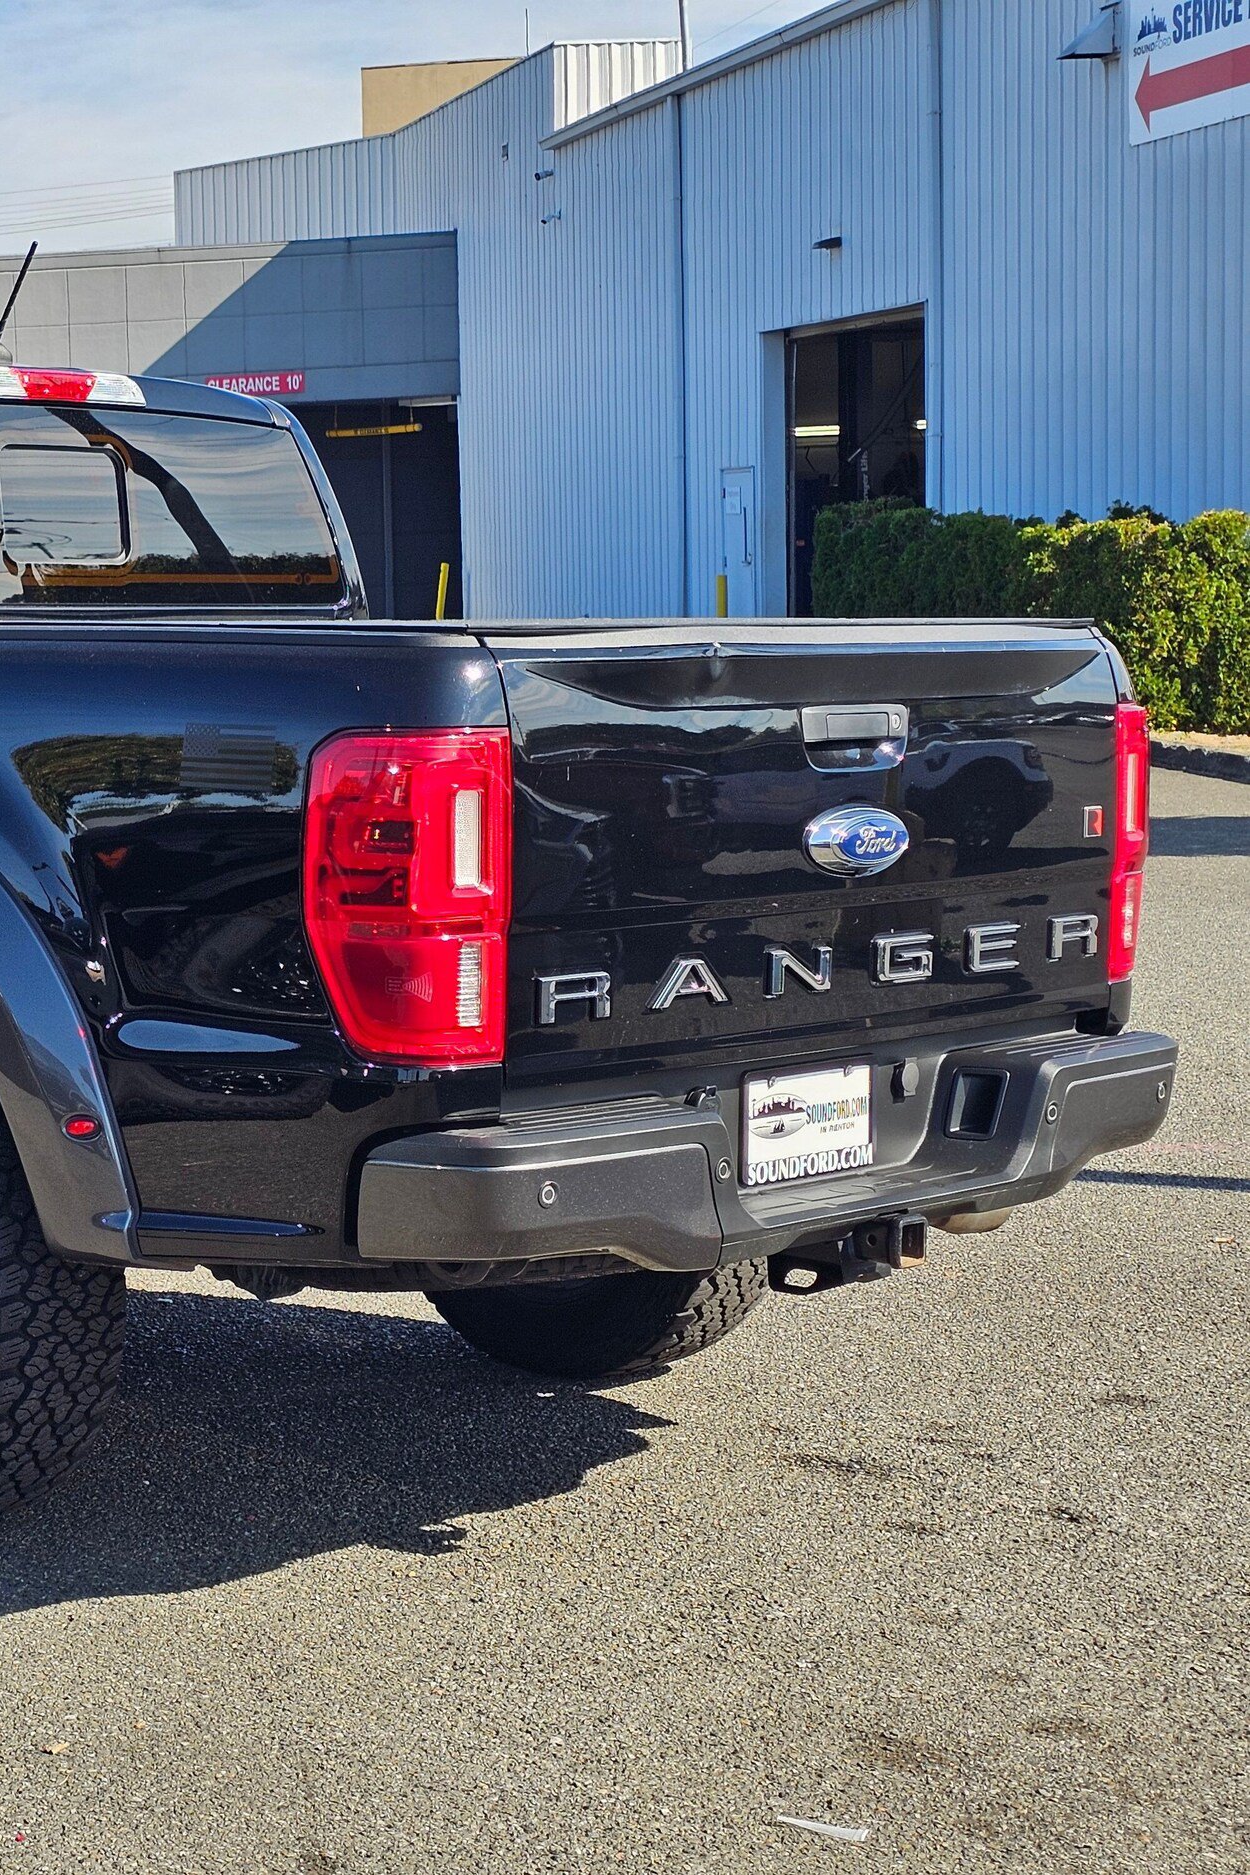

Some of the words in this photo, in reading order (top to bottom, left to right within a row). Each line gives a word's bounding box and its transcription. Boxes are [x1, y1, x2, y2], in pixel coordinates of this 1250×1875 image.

[1172, 0, 1243, 44] SERVICE
[287, 374, 302, 390] 10'
[855, 824, 897, 855] Ford
[534, 914, 1098, 1026] RANGER
[805, 1096, 868, 1125] SOUNDFORD.COM
[747, 1142, 874, 1186] SOUNDFORD.COM
